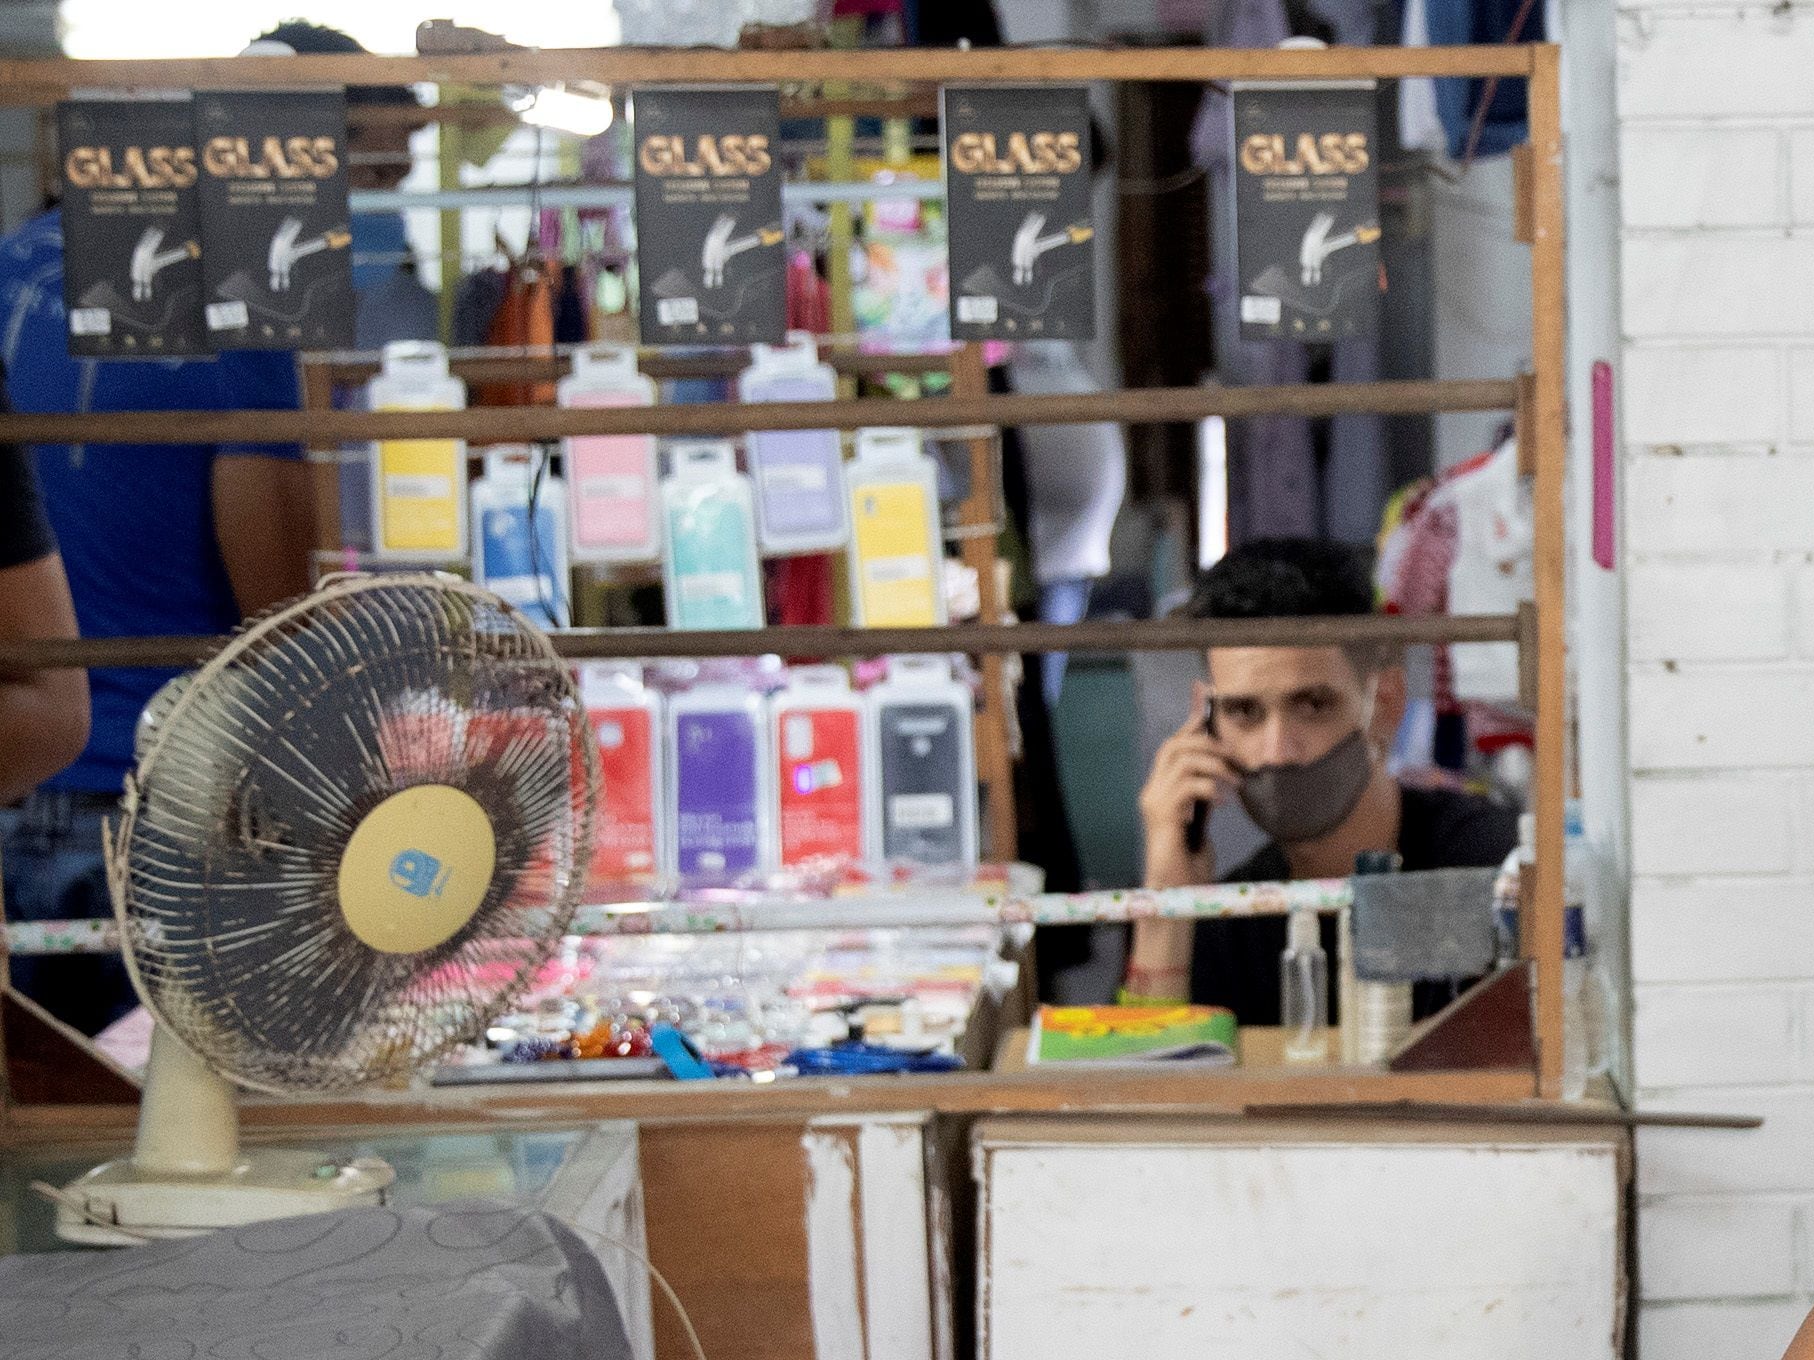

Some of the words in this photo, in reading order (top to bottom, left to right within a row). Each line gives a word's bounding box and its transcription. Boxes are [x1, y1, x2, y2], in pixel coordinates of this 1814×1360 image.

[66, 145, 198, 188] GLASS
[202, 136, 339, 178] GLASS
[640, 134, 771, 176] GLASS
[951, 131, 1081, 174] GLASS
[1240, 132, 1369, 175] GLASS
